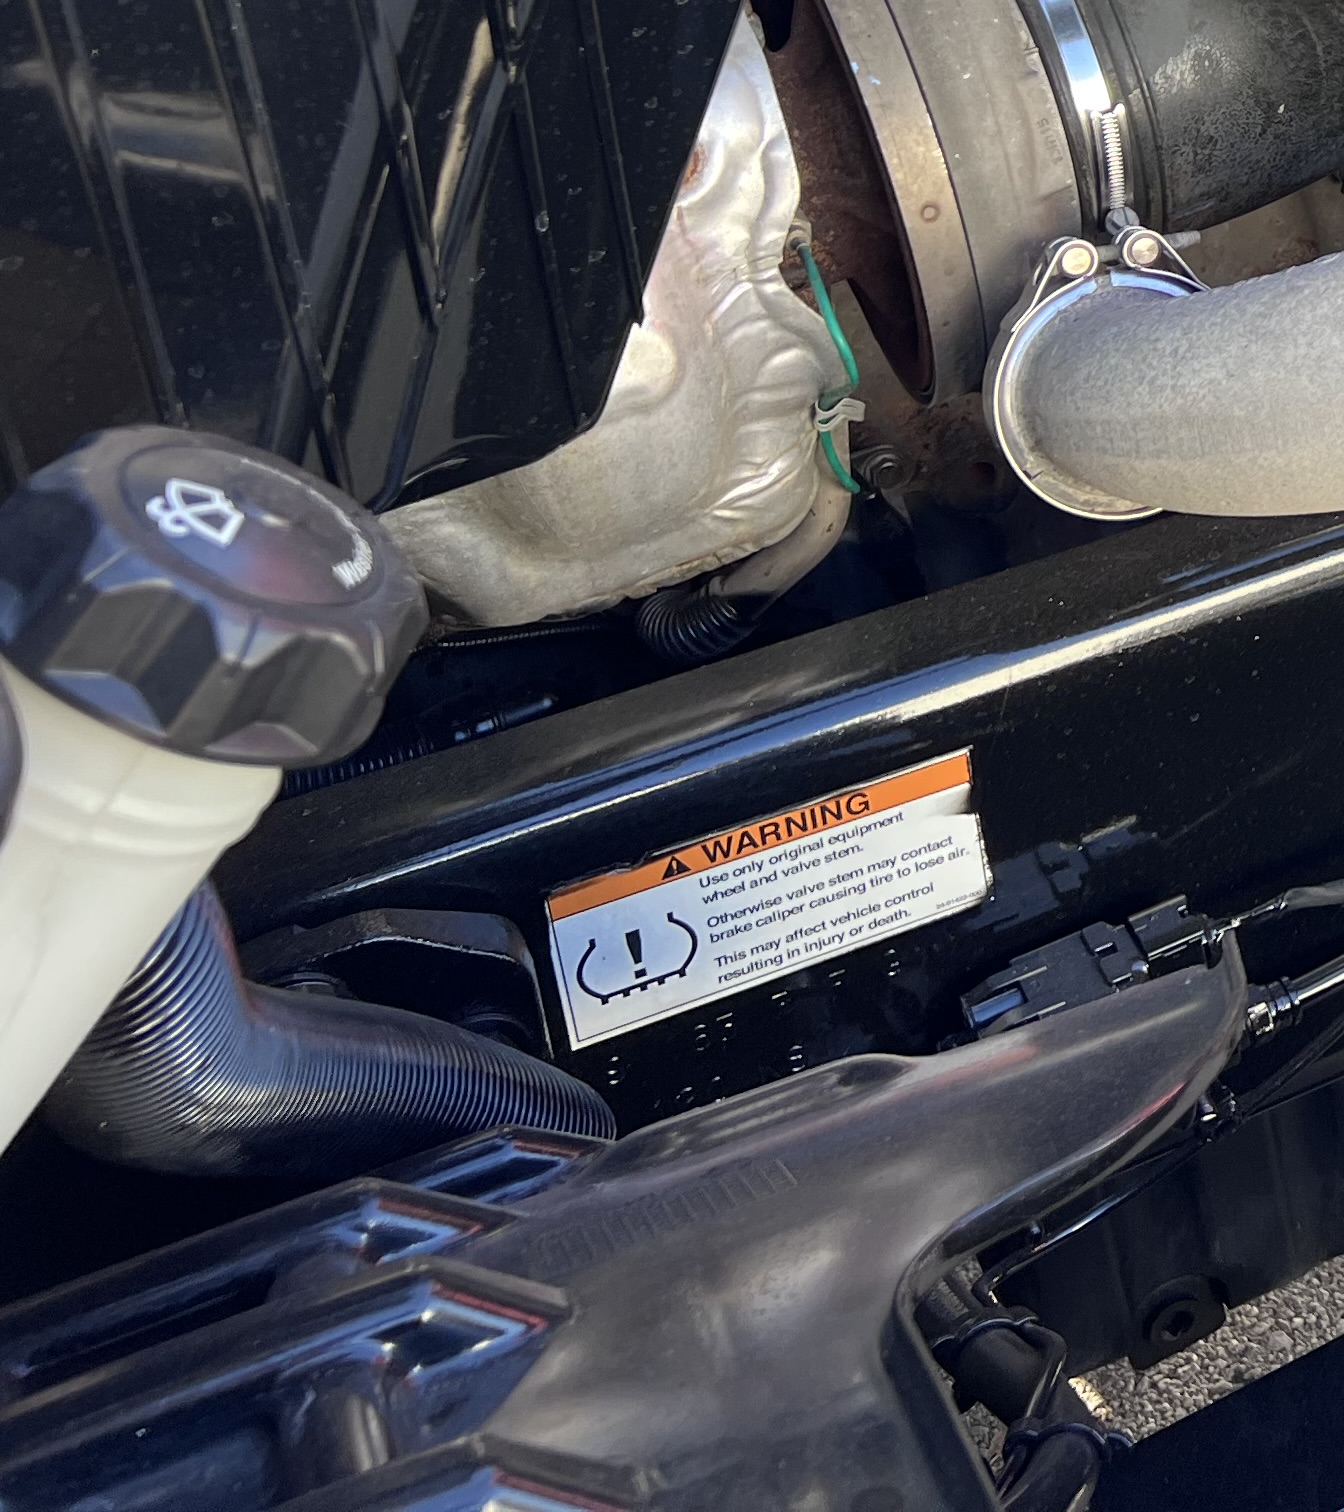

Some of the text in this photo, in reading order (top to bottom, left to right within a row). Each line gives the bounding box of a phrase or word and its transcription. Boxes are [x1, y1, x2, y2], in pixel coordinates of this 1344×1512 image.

[699, 811, 905, 889] Use only original equipment
[701, 791, 871, 864] WARNING
[702, 844, 864, 905] wheel and valve stem.
[707, 836, 953, 928] Otherwise valve stem may contact
[710, 846, 971, 944] brake caliper causing tire to lose air.
[714, 883, 935, 968] This may affect vehicle control
[718, 908, 912, 984] resulting in injury or death.
